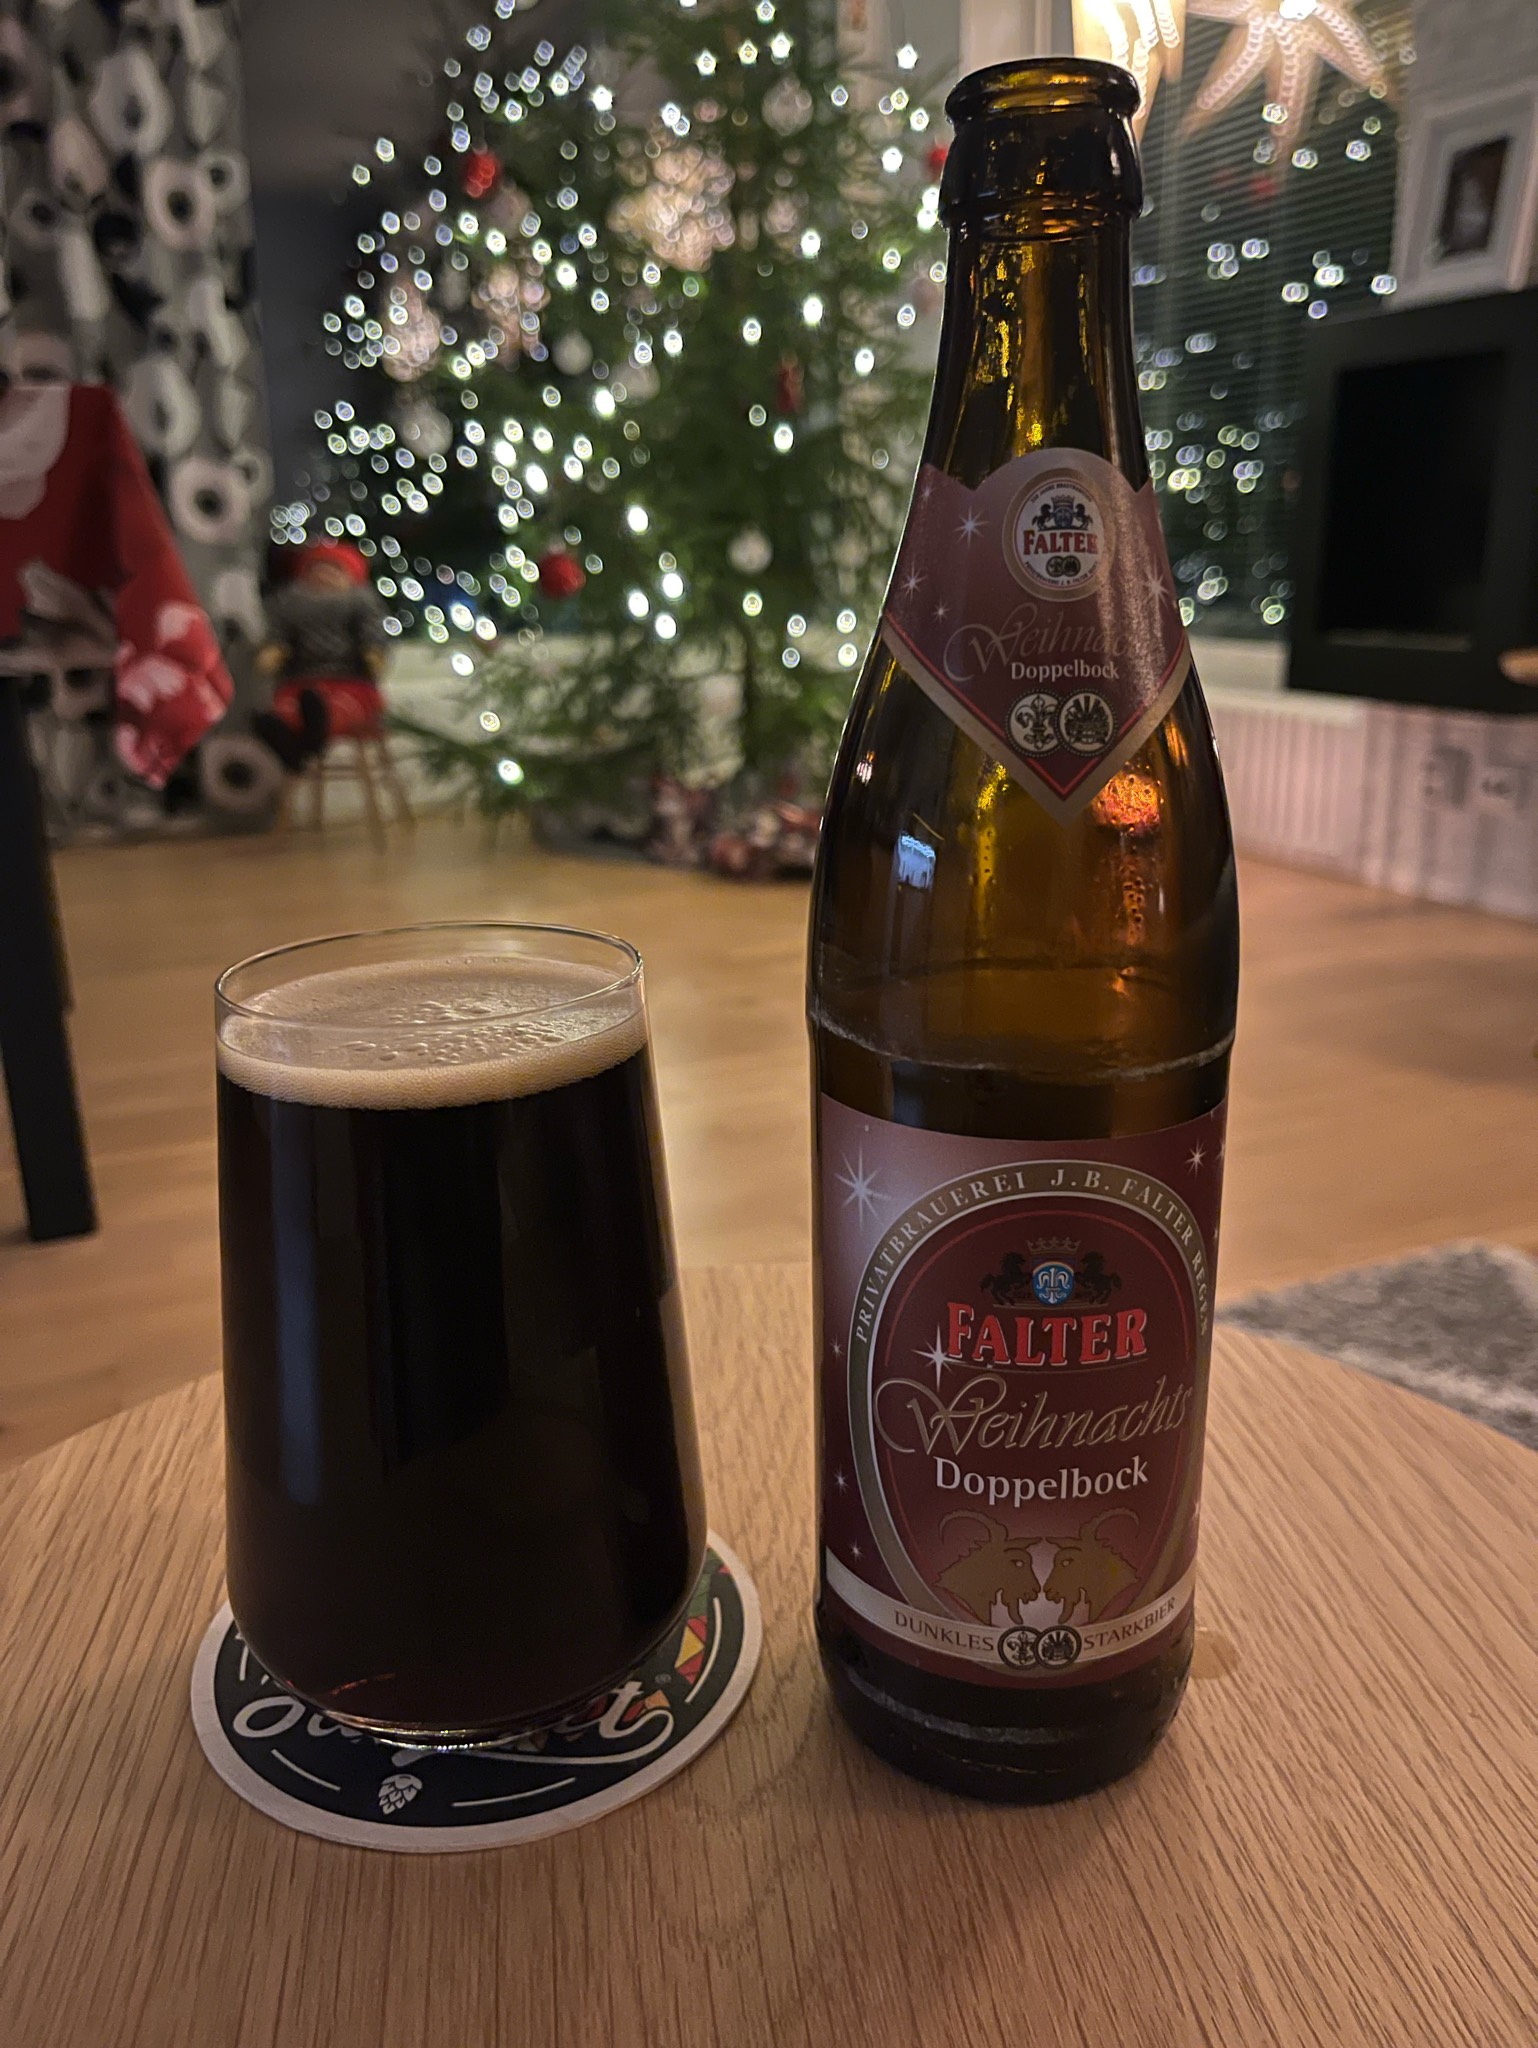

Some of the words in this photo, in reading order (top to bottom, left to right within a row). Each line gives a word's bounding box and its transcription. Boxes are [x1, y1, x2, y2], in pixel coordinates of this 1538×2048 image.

[1023, 528, 1099, 555] FALTER
[943, 602, 1132, 682] Weihnac
[1010, 660, 1120, 683] Doppelbock
[855, 1170, 1026, 1344] PRIVATBRAUEREI
[1120, 1177, 1194, 1247] FALTER
[946, 1301, 1148, 1367] FALTER
[873, 1373, 1193, 1456] Weihnachts
[933, 1455, 1149, 1508] Doppelbock
[893, 1609, 995, 1653] DUNKLES
[1082, 1597, 1177, 1651] STARKBIER
